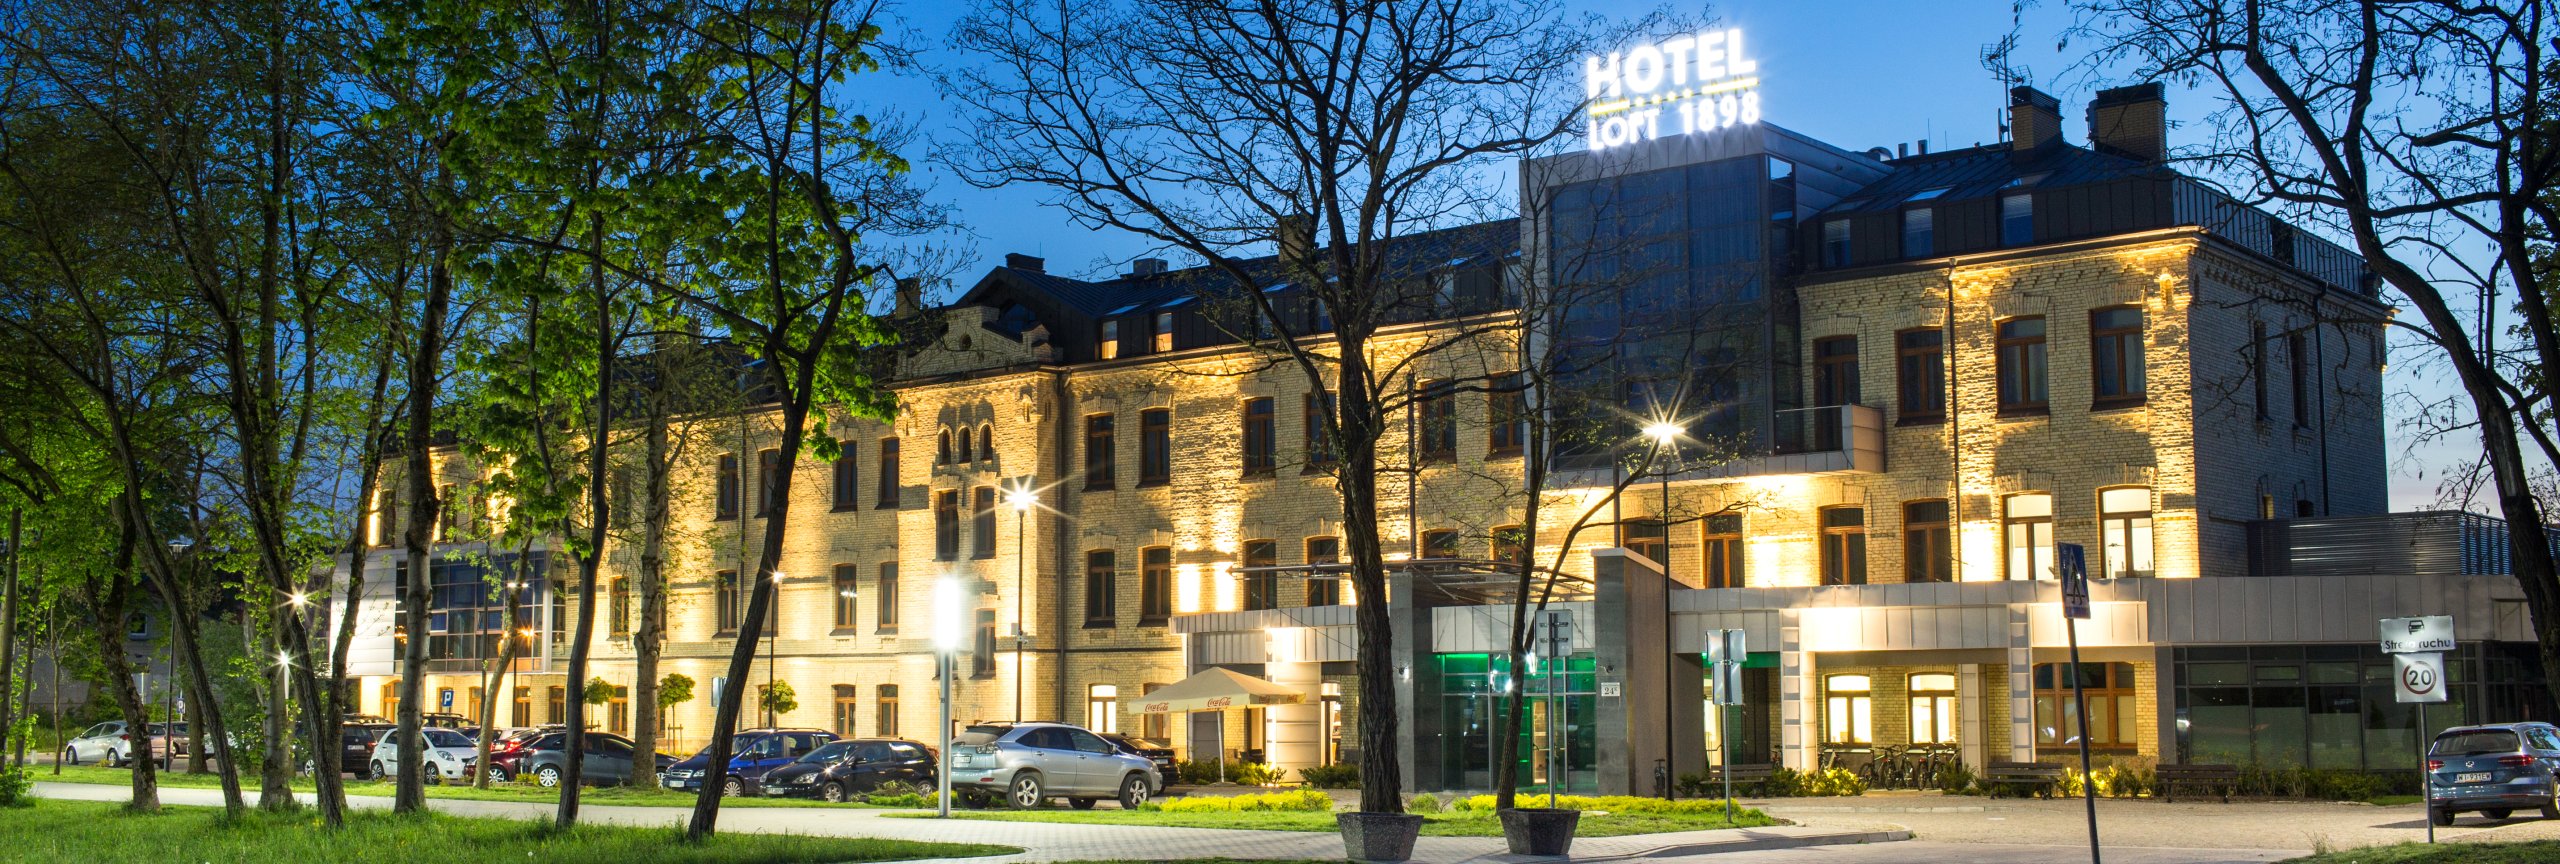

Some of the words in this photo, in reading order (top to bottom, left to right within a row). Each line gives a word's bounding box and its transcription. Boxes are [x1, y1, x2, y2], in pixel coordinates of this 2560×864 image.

[1587, 29, 1756, 98] HOTEL
[1589, 108, 1659, 150] LOFT
[1680, 91, 1759, 134] 1898
[2385, 640, 2416, 650] Strea
[2419, 638, 2451, 649] ruchu
[2409, 670, 2432, 686] 20
[444, 691, 452, 705] P
